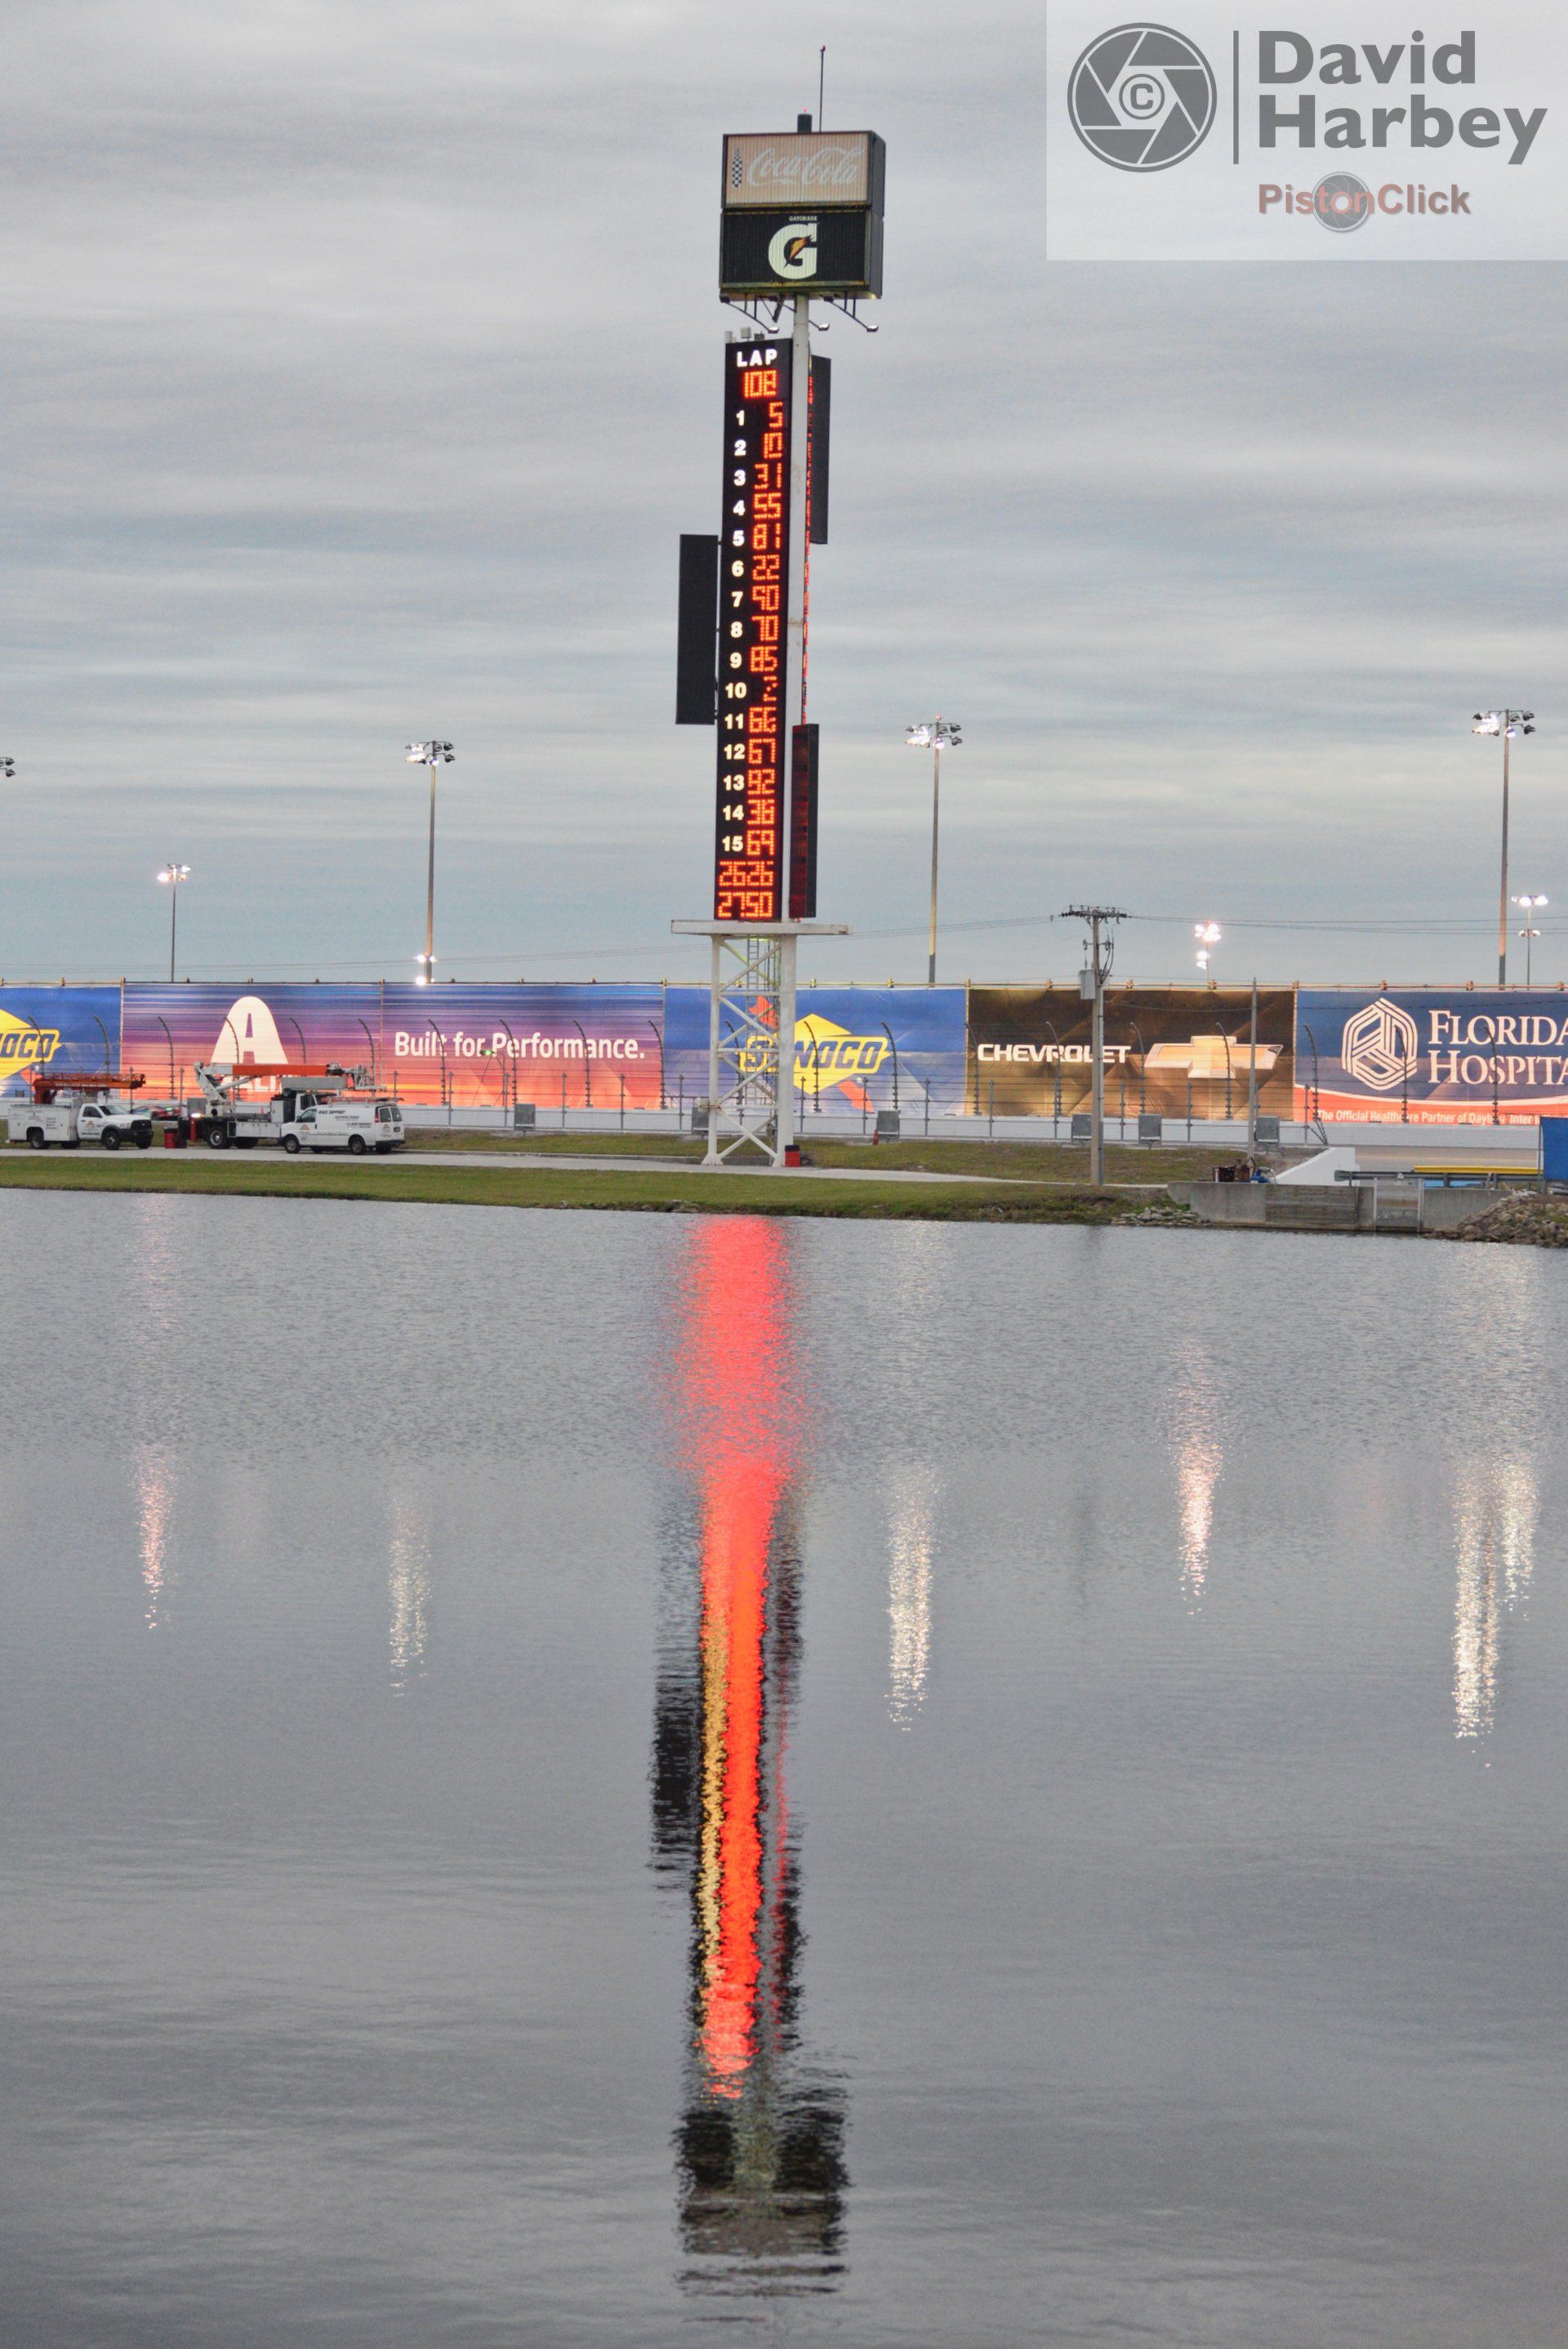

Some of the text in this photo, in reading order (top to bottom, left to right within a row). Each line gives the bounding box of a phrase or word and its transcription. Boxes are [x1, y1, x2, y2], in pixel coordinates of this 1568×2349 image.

[737, 349, 777, 367] LAP
[744, 370, 777, 398] 108
[736, 401, 782, 428] 1 5
[734, 439, 746, 456] 2
[733, 462, 782, 489] 3 31
[733, 500, 746, 515] 4
[733, 523, 781, 550] 5 81
[732, 555, 779, 581] 6 22
[732, 585, 779, 611] 7 90
[730, 615, 778, 641] 8 70
[730, 646, 777, 672] 9 85
[725, 682, 747, 698] 10
[724, 714, 744, 729] 11
[724, 738, 776, 764] 12 67
[723, 774, 745, 791] 13
[723, 805, 744, 821] 14
[722, 830, 774, 855] 15 69
[0, 1034, 56, 1058] OCO
[394, 1032, 644, 1059] Built for Performance.
[744, 1040, 883, 1068] SNOCO
[978, 1044, 1132, 1063] CHEVROLET
[1318, 1109, 1333, 1120] The
[1336, 1110, 1368, 1121] Official
[1422, 1112, 1454, 1123] Partner
[1458, 1112, 1466, 1123] of
